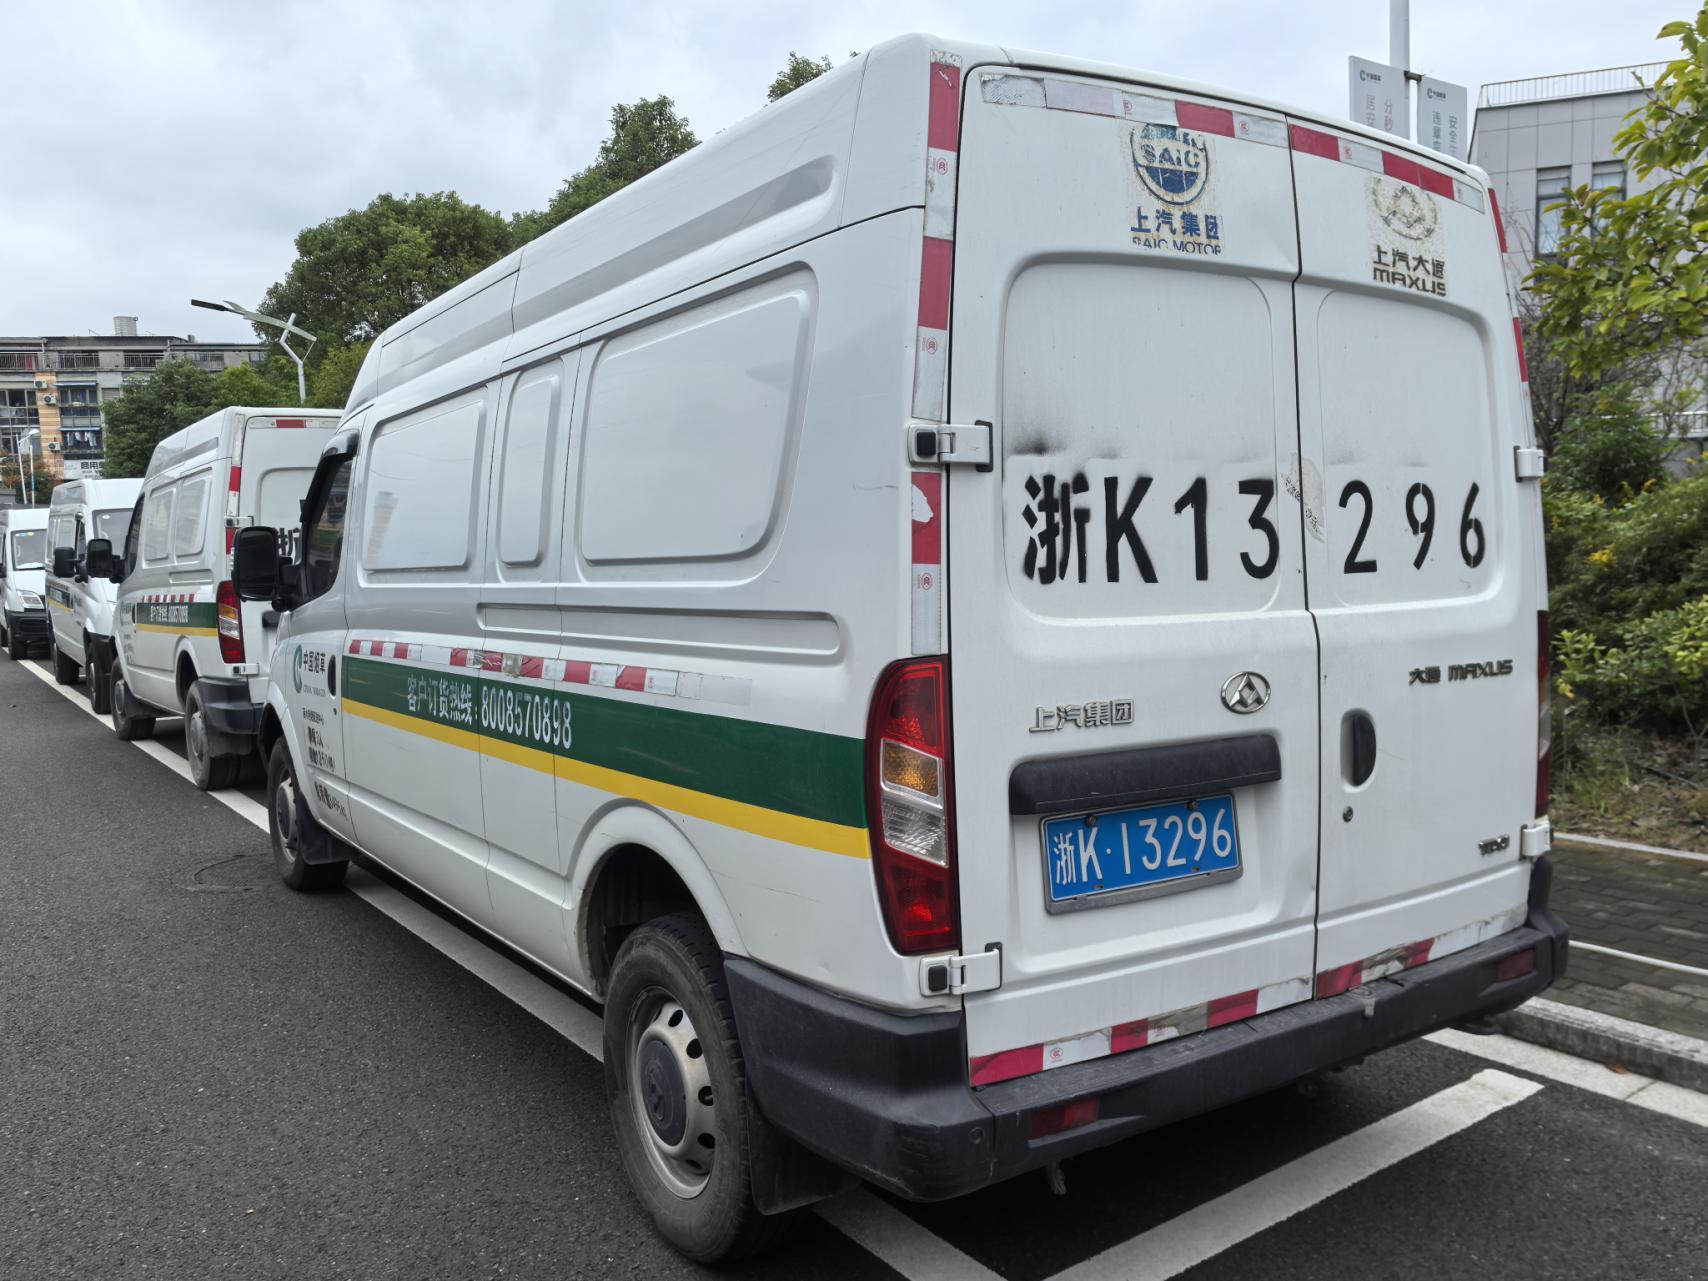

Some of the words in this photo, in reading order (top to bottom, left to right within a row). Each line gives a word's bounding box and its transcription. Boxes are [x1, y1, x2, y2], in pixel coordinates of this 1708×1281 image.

[1130, 206, 1220, 240] 上汽集团
[1372, 244, 1445, 279] 上汽大通
[1372, 267, 1447, 297] MAXUS
[1448, 659, 1513, 682] MAXUS
[1028, 698, 1135, 734] 上汽集团
